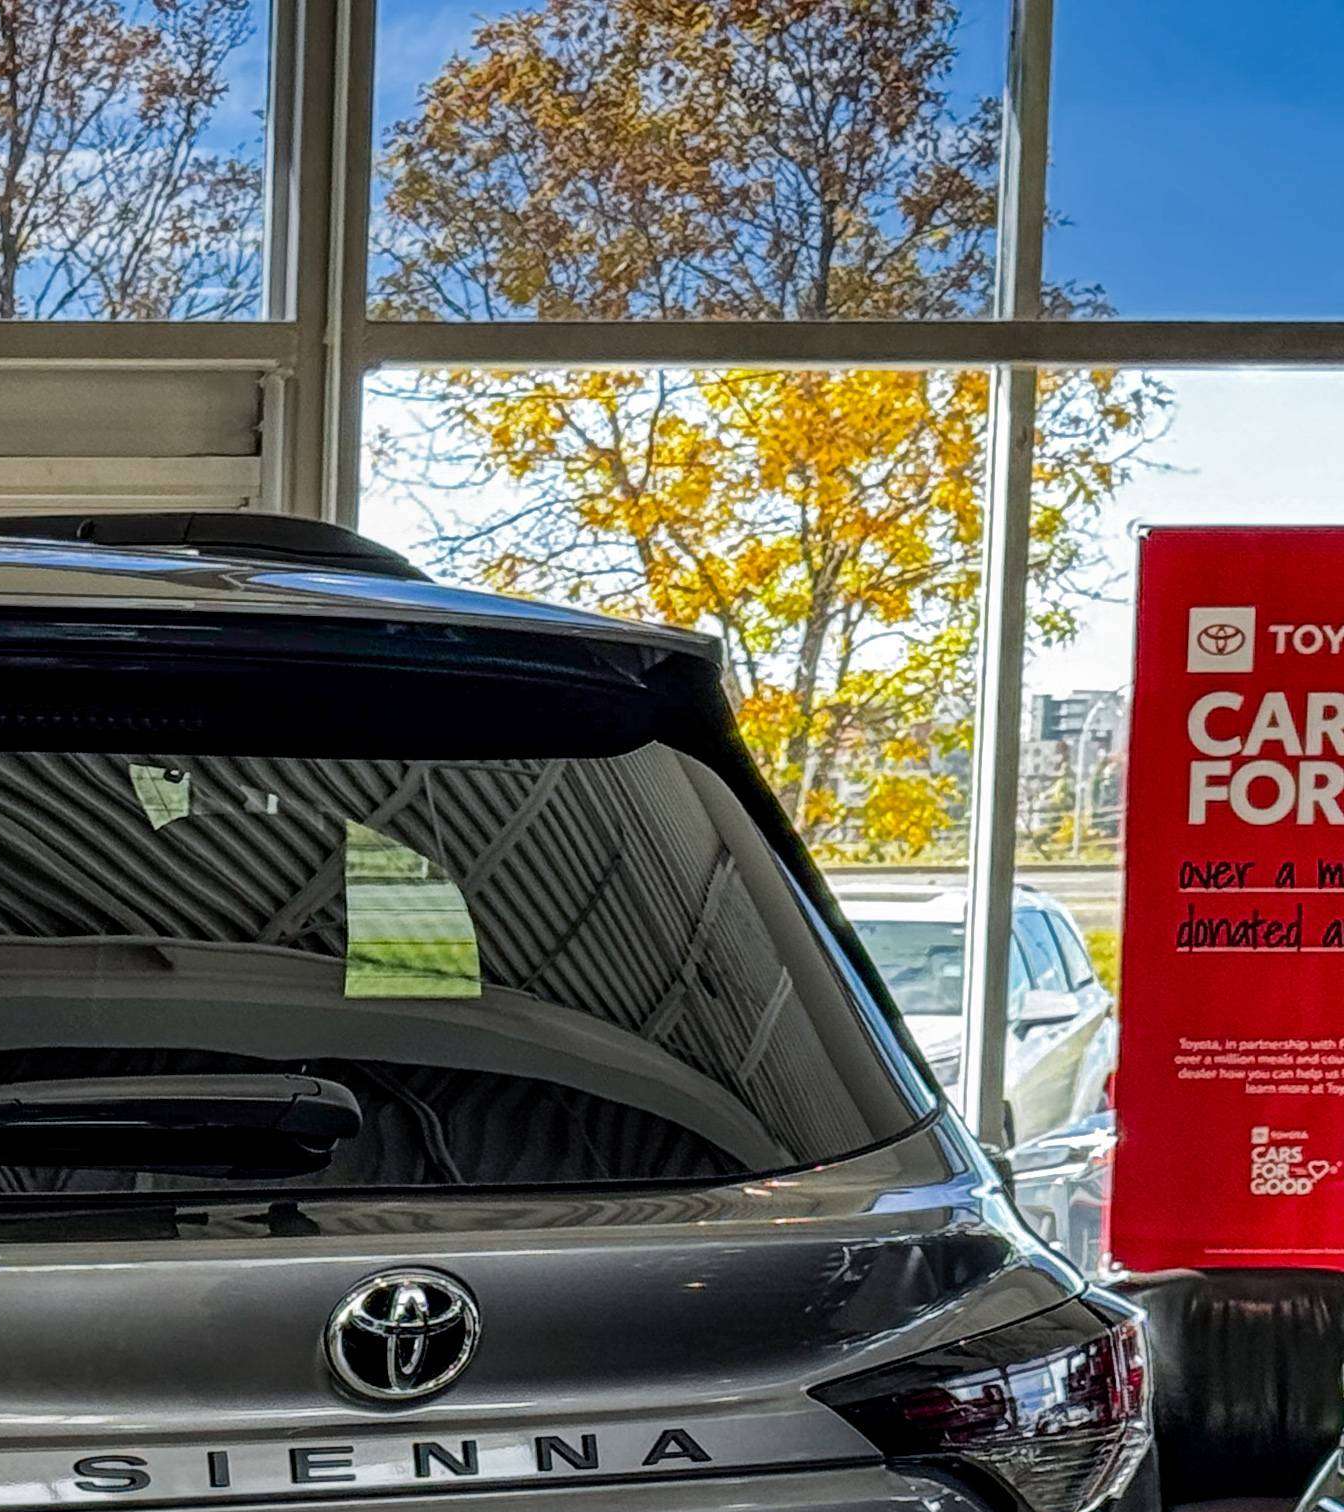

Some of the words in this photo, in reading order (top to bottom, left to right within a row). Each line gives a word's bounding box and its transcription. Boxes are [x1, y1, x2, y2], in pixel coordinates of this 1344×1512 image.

[1267, 624, 1344, 655] TOY
[1187, 690, 1344, 757] CAR
[1188, 759, 1344, 826] FOR
[1179, 860, 1255, 889] over
[1275, 861, 1296, 889] a
[1176, 902, 1303, 951] donated
[1179, 1037, 1222, 1051] Toyota,
[1225, 1039, 1237, 1050] in
[1238, 1038, 1309, 1051] partnership
[1310, 1038, 1337, 1050] with
[1174, 1054, 1202, 1065] over
[1213, 1053, 1256, 1065] million
[1296, 1053, 1320, 1065] and
[1219, 1068, 1246, 1079] how
[1247, 1070, 1271, 1081] you
[1272, 1070, 1294, 1079] can
[1296, 1068, 1323, 1081] help
[1278, 1084, 1310, 1094] more
[1311, 1083, 1324, 1094] at
[1252, 1146, 1304, 1163] CARS
[1252, 1163, 1290, 1179] FOR
[1250, 1178, 1313, 1195] GOOD
[73, 1428, 714, 1494] SIENNA
